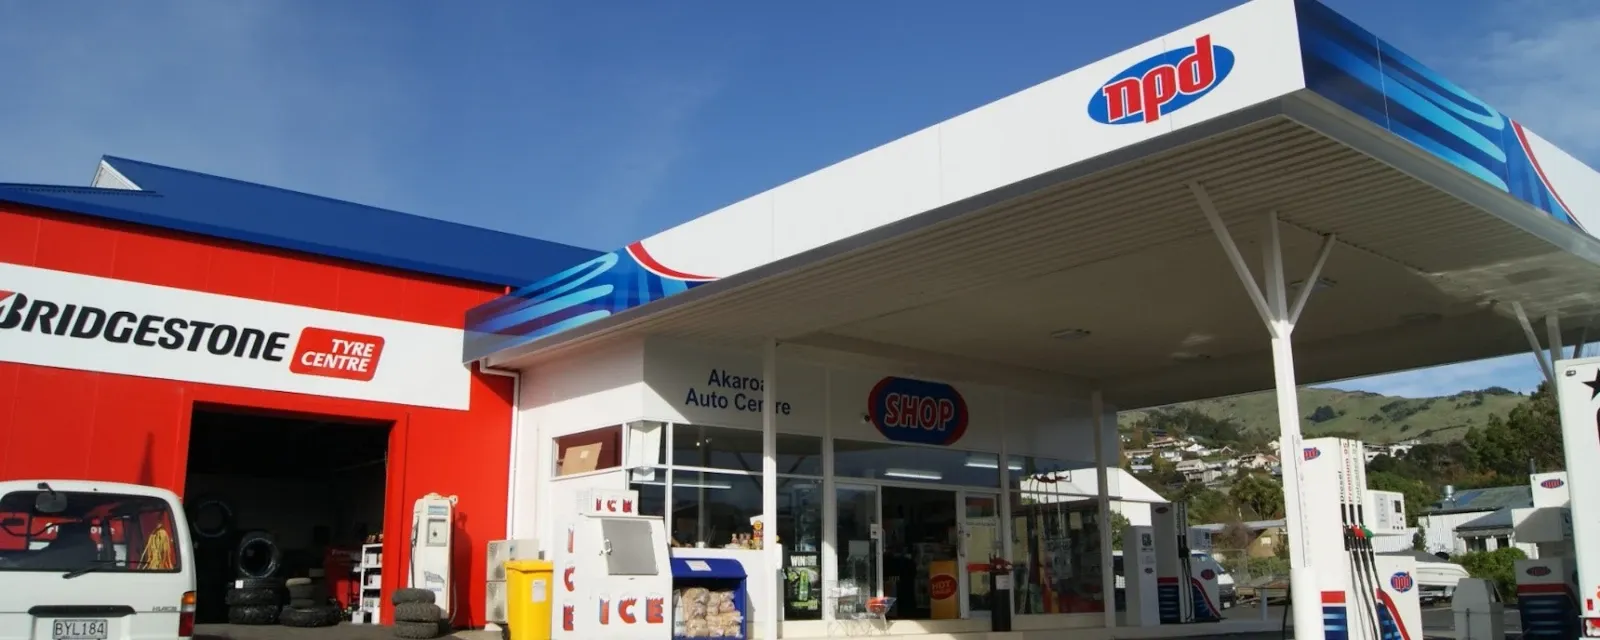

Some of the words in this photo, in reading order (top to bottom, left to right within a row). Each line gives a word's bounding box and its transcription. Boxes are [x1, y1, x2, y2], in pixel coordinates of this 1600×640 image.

[1103, 33, 1217, 124] npd
[0, 292, 290, 362] BRIDGESTONE
[331, 338, 375, 358] TYRE
[301, 351, 371, 373] CENTRE
[708, 368, 764, 392] Akaro
[685, 387, 728, 410] Auto
[884, 392, 954, 431] SHOP
[598, 594, 664, 625] ICE
